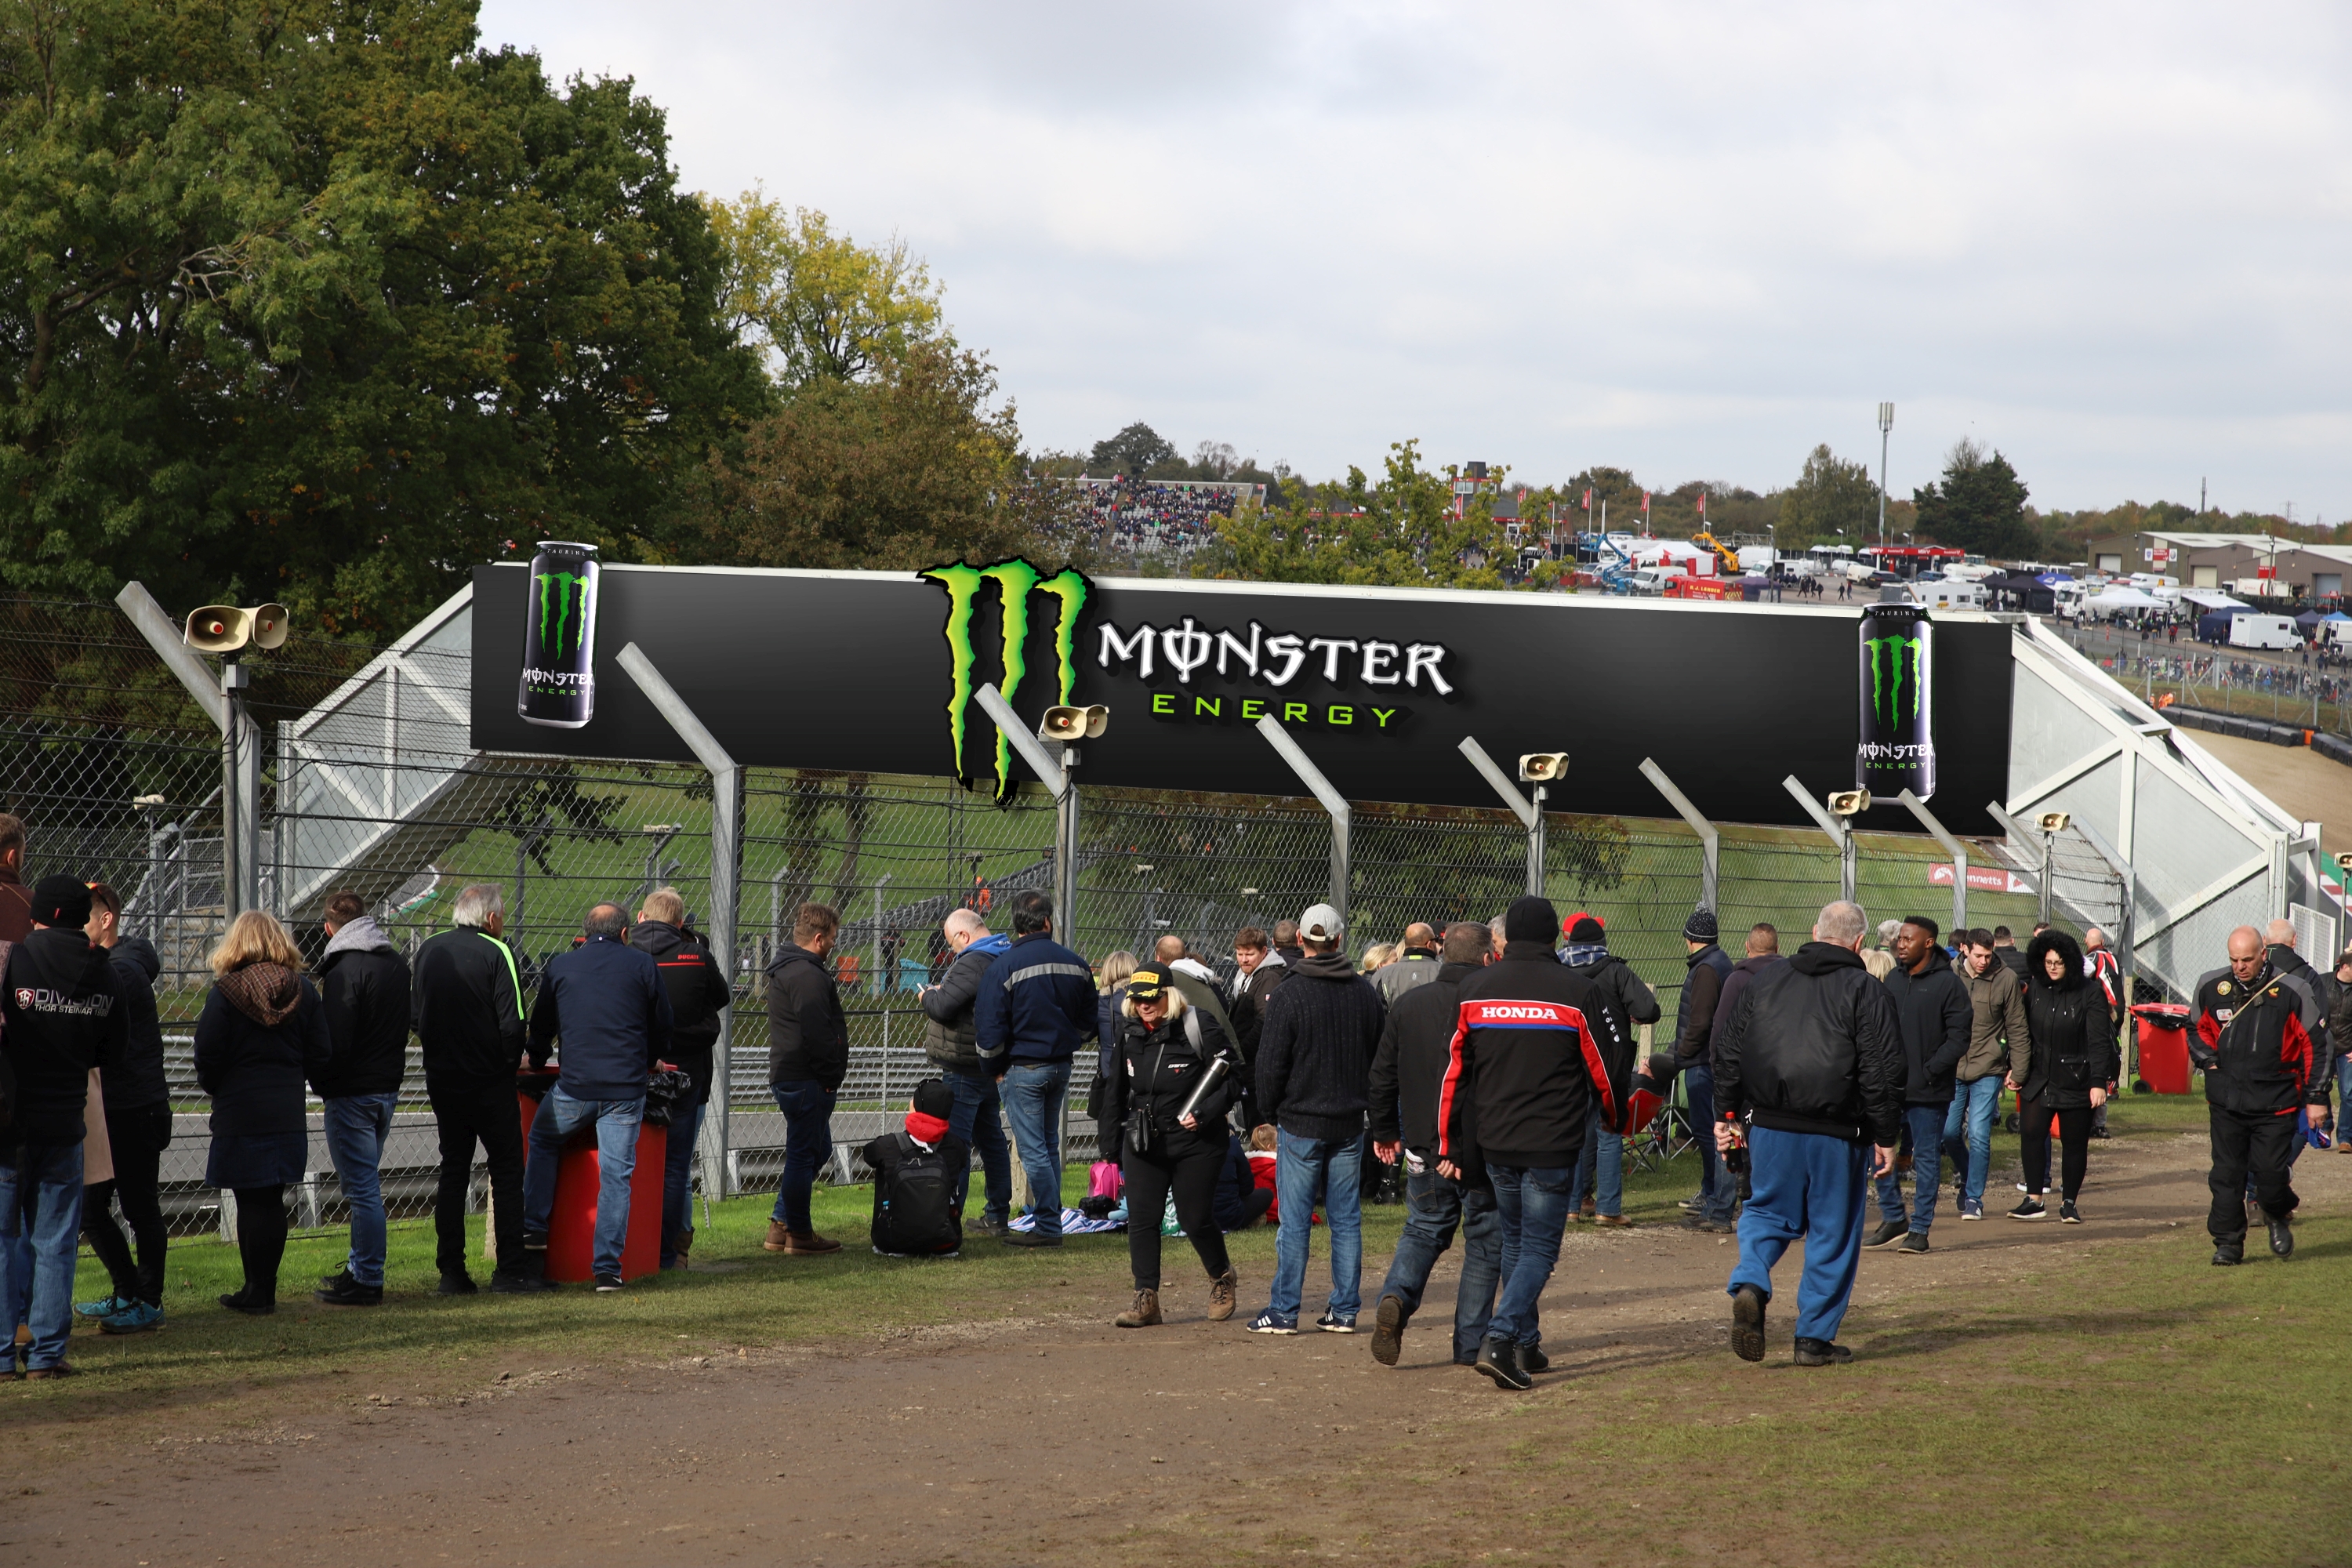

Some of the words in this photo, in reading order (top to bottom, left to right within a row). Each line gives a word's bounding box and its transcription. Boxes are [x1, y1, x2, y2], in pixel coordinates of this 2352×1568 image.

[546, 548, 586, 557] TAURINE
[1098, 618, 1454, 695] MONSTER
[528, 685, 586, 695] ENERGY
[1152, 694, 1396, 728] ENERGY
[1967, 874, 2002, 886] nnetts
[59, 1006, 93, 1015] STEINAR
[1481, 1006, 1559, 1020] HONDA
